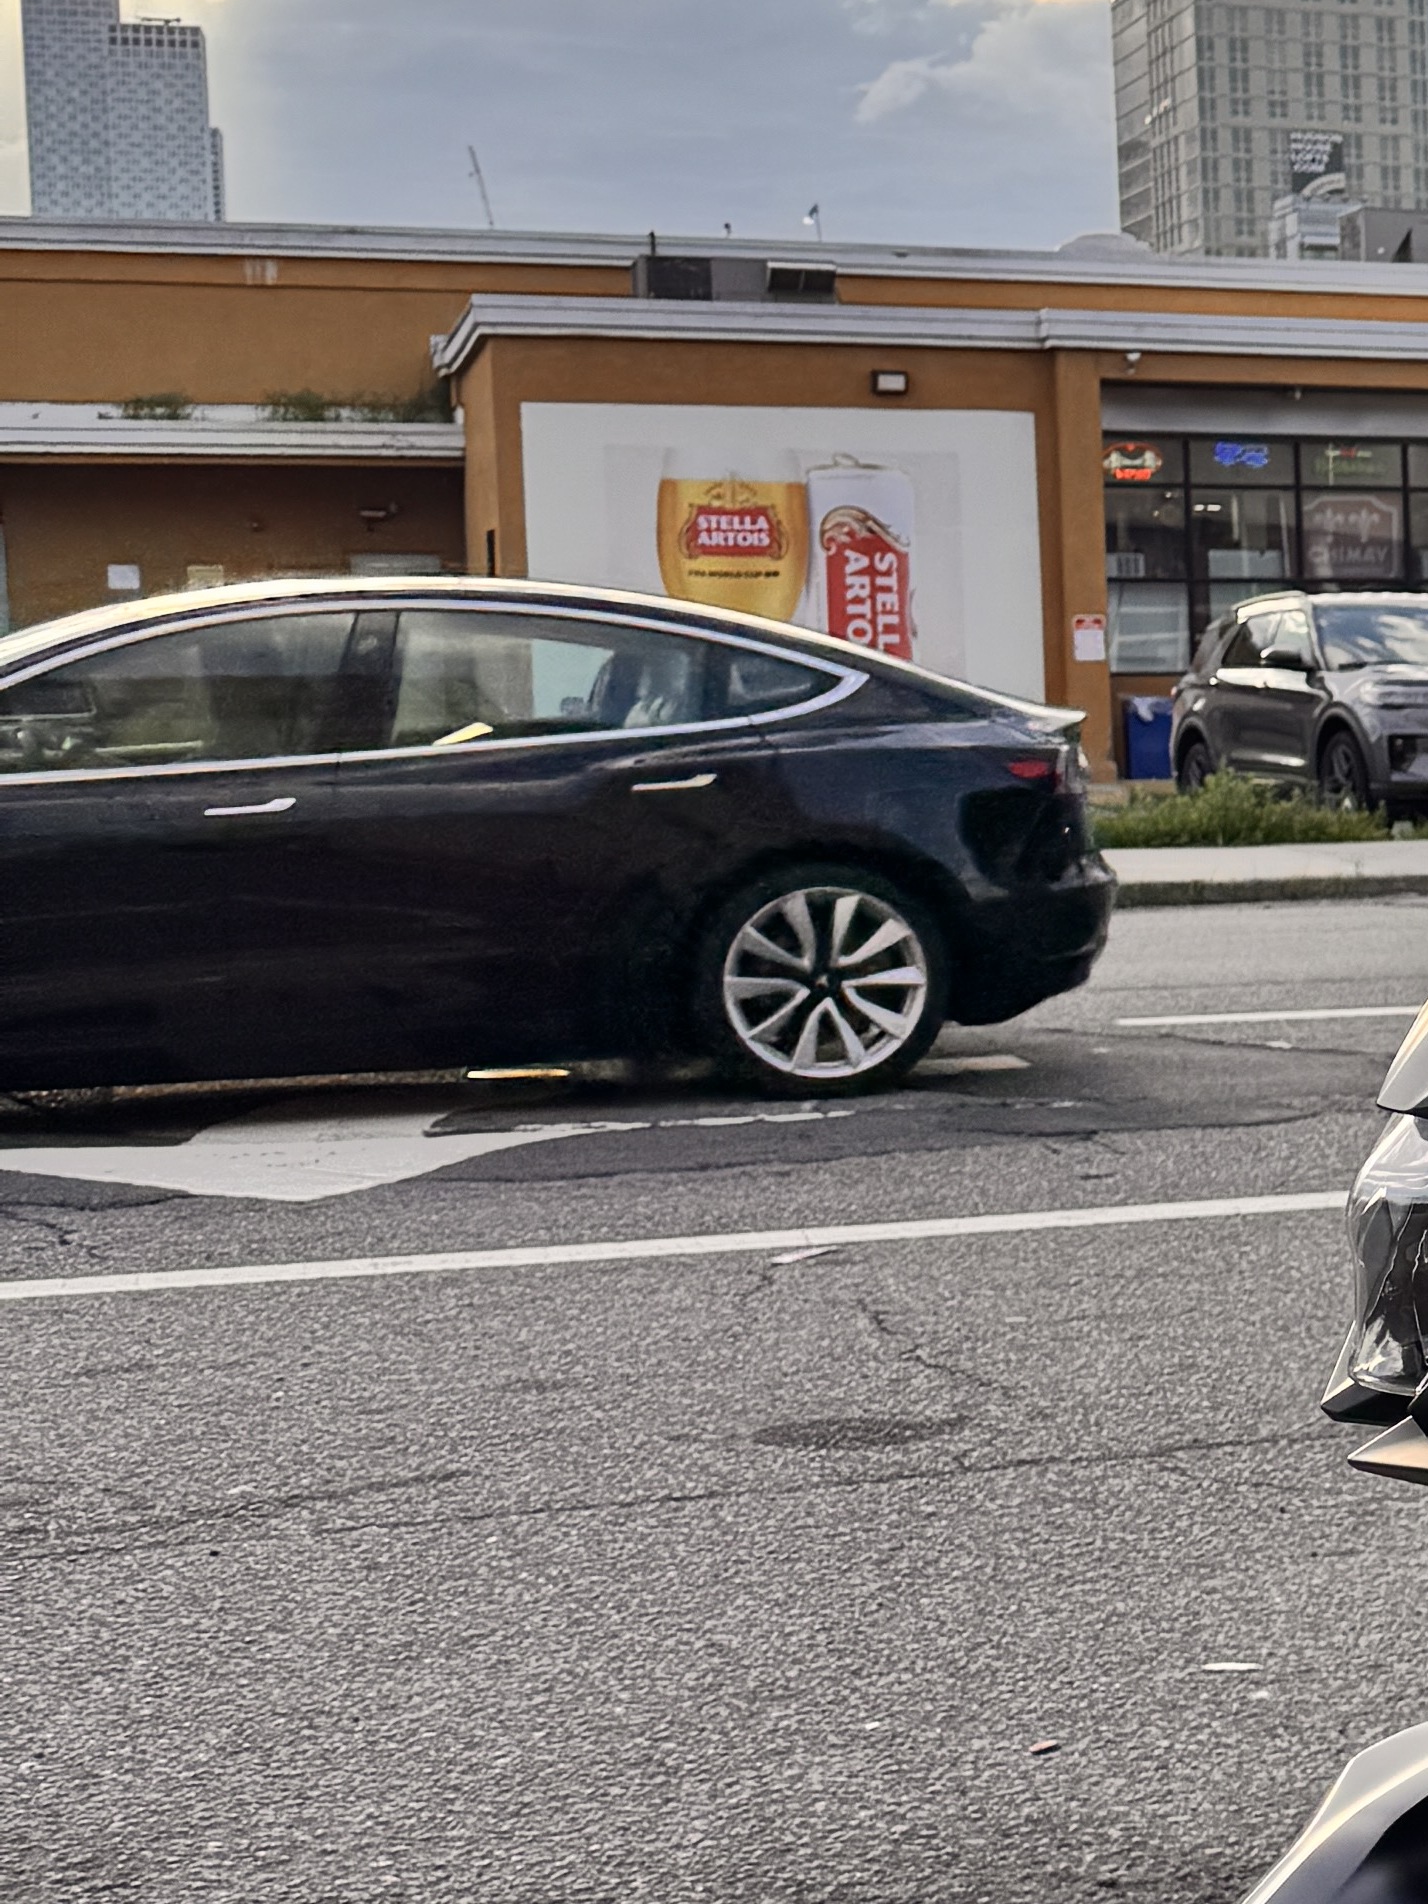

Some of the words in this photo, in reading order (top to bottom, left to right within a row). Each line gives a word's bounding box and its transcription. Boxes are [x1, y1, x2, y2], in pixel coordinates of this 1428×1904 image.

[696, 514, 770, 531] STELLA
[697, 530, 771, 547] ARTOIS
[844, 549, 873, 646] ARTO
[874, 551, 900, 652] STELL
